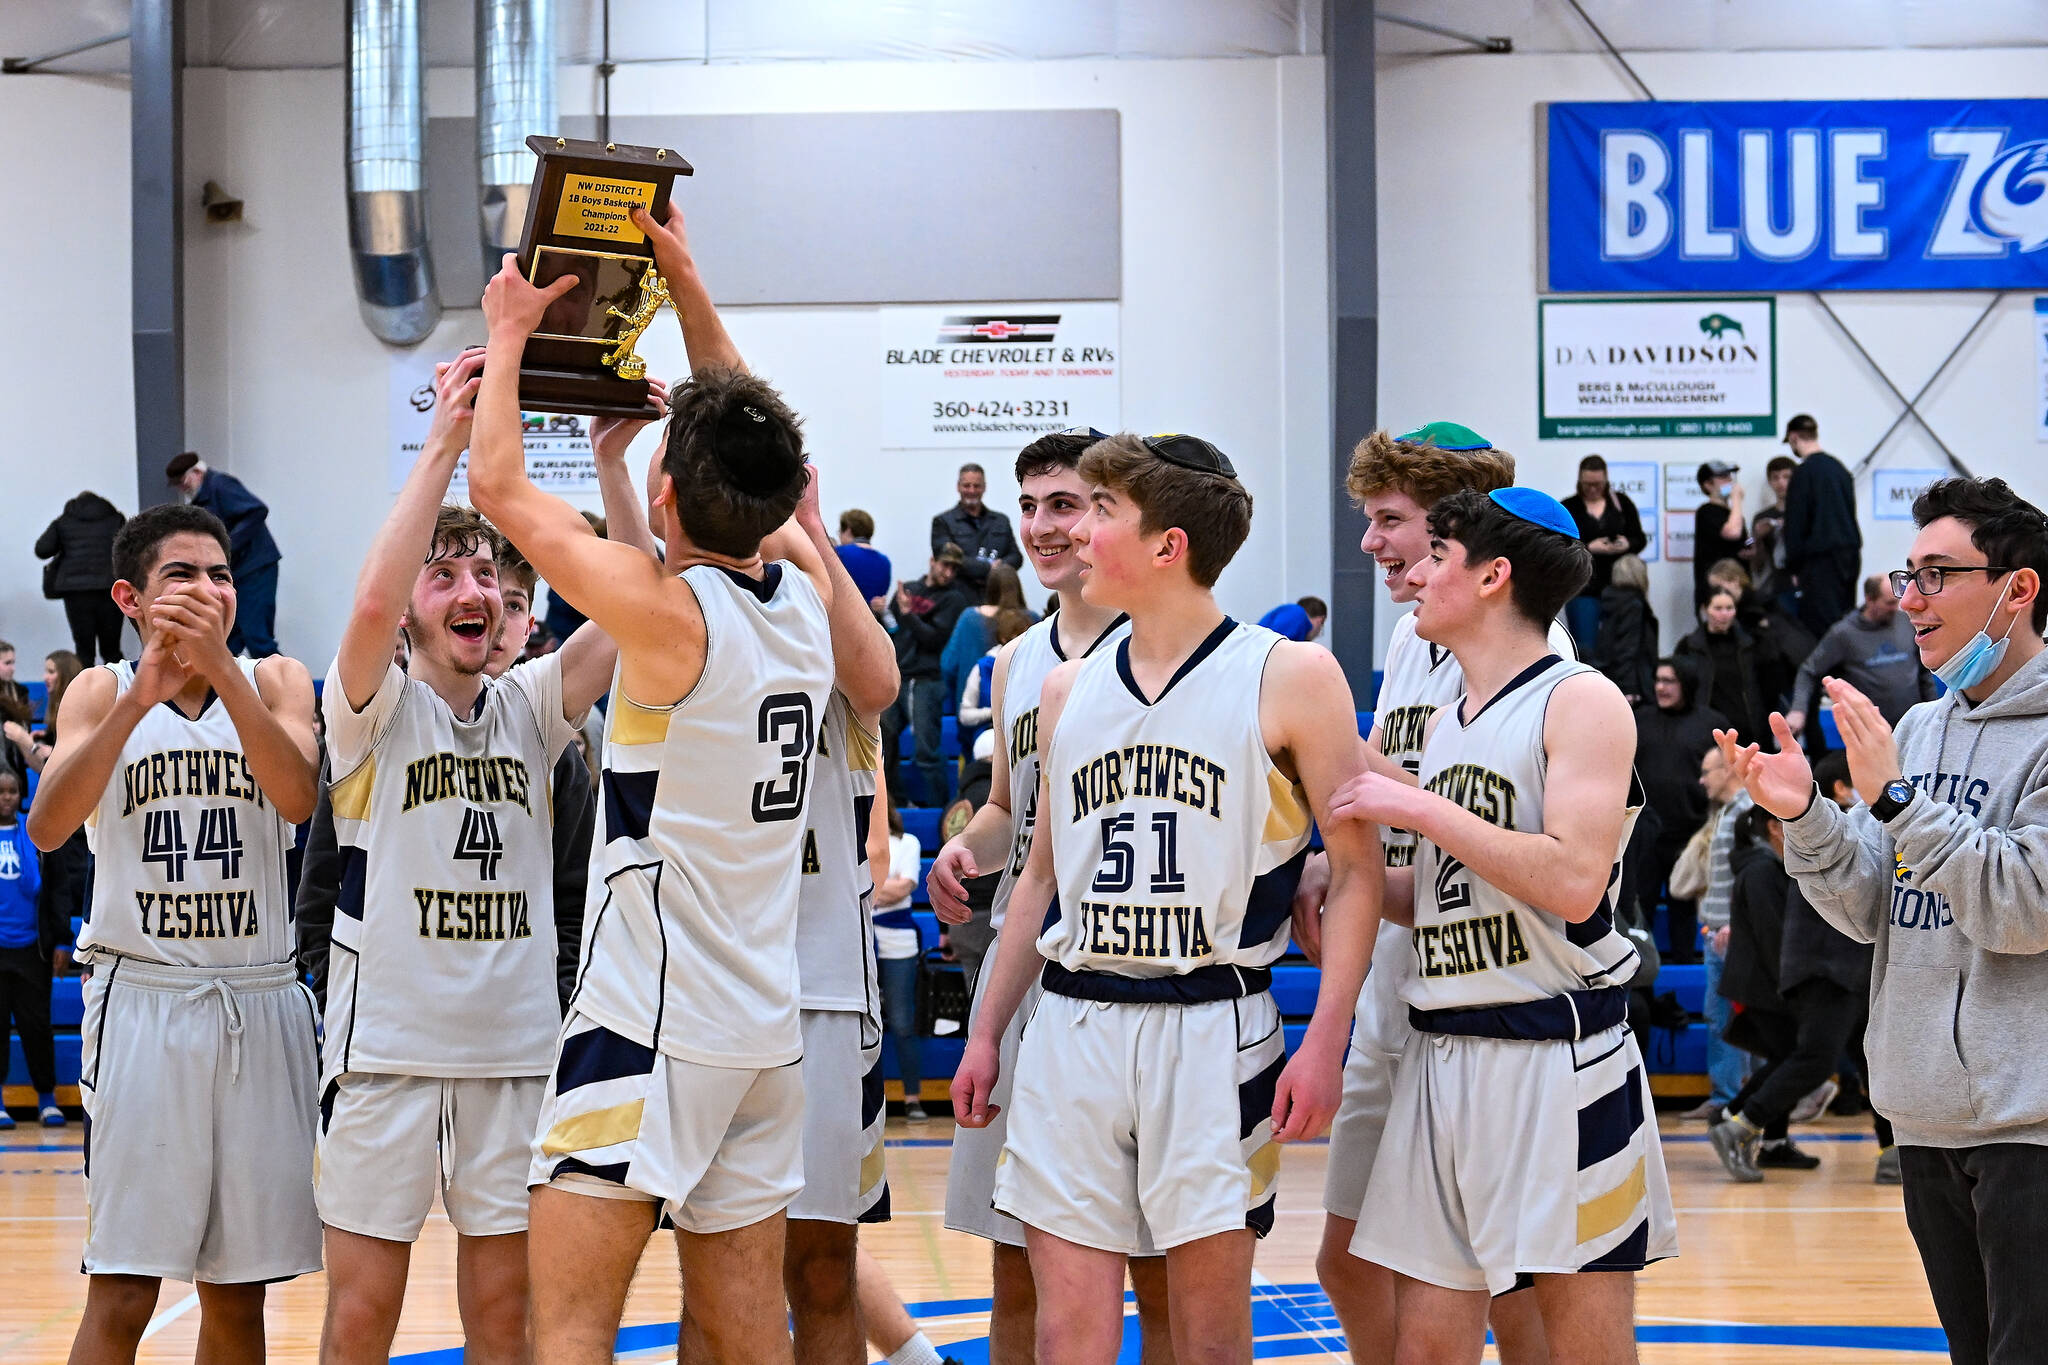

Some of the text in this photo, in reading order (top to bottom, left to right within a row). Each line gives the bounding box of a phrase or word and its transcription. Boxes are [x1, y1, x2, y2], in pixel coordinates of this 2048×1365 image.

[578, 181, 643, 196] NW DISTRICT 1
[1601, 127, 1888, 261] BLUE
[568, 194, 647, 210] 1B Boys Basketball
[581, 208, 628, 222] Champions
[583, 222, 619, 234] 2021-22
[886, 347, 1115, 364] BLADE CHEVROLET & RVs
[1608, 345, 1759, 364] DAVIDSON
[1578, 382, 1612, 392] BERG
[1615, 382, 1624, 392] &
[1578, 392, 1726, 405] WEALTH MANAGEMENT
[933, 421, 1066, 434] www.bladechevy.com
[532, 460, 597, 469] BURLINGTO
[751, 691, 815, 824] 3
[122, 749, 264, 818] NORTHWES
[141, 807, 243, 883] 44
[452, 806, 503, 881] 4
[1091, 811, 1186, 894] 51
[135, 889, 259, 940] YESHIVA
[413, 888, 533, 942] YESHIVA
[1890, 885, 1955, 931] IONS
